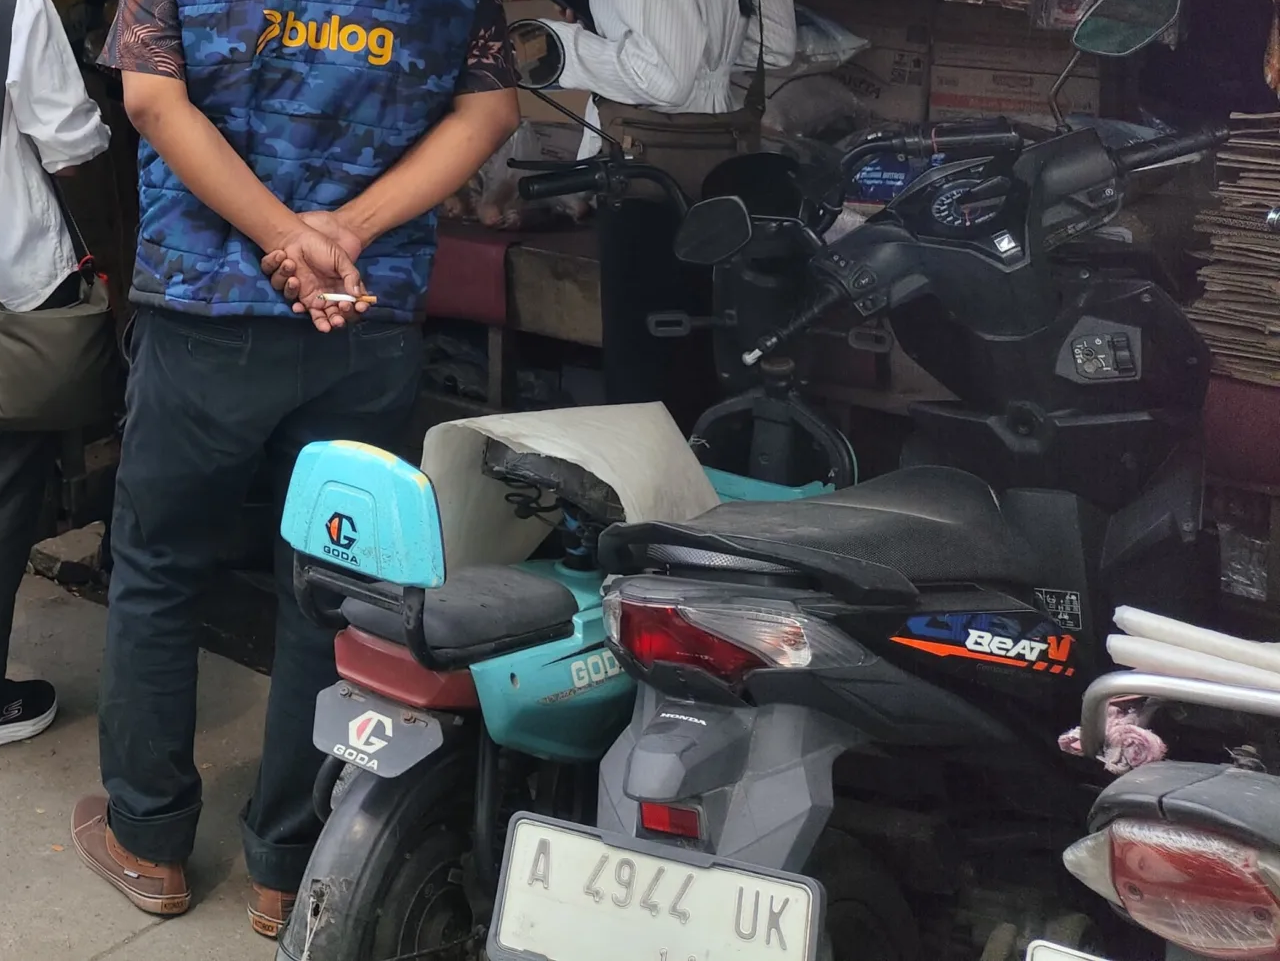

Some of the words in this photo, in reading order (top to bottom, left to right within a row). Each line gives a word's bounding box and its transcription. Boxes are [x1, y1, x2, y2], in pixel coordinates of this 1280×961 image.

[281, 10, 394, 66] bulog
[323, 544, 359, 565] GODA
[570, 647, 625, 688] GOD
[660, 712, 707, 726] HONDA
[332, 743, 379, 771] GODA
[527, 837, 552, 889] A
[583, 852, 697, 925] 4944
[733, 885, 791, 951] UK
